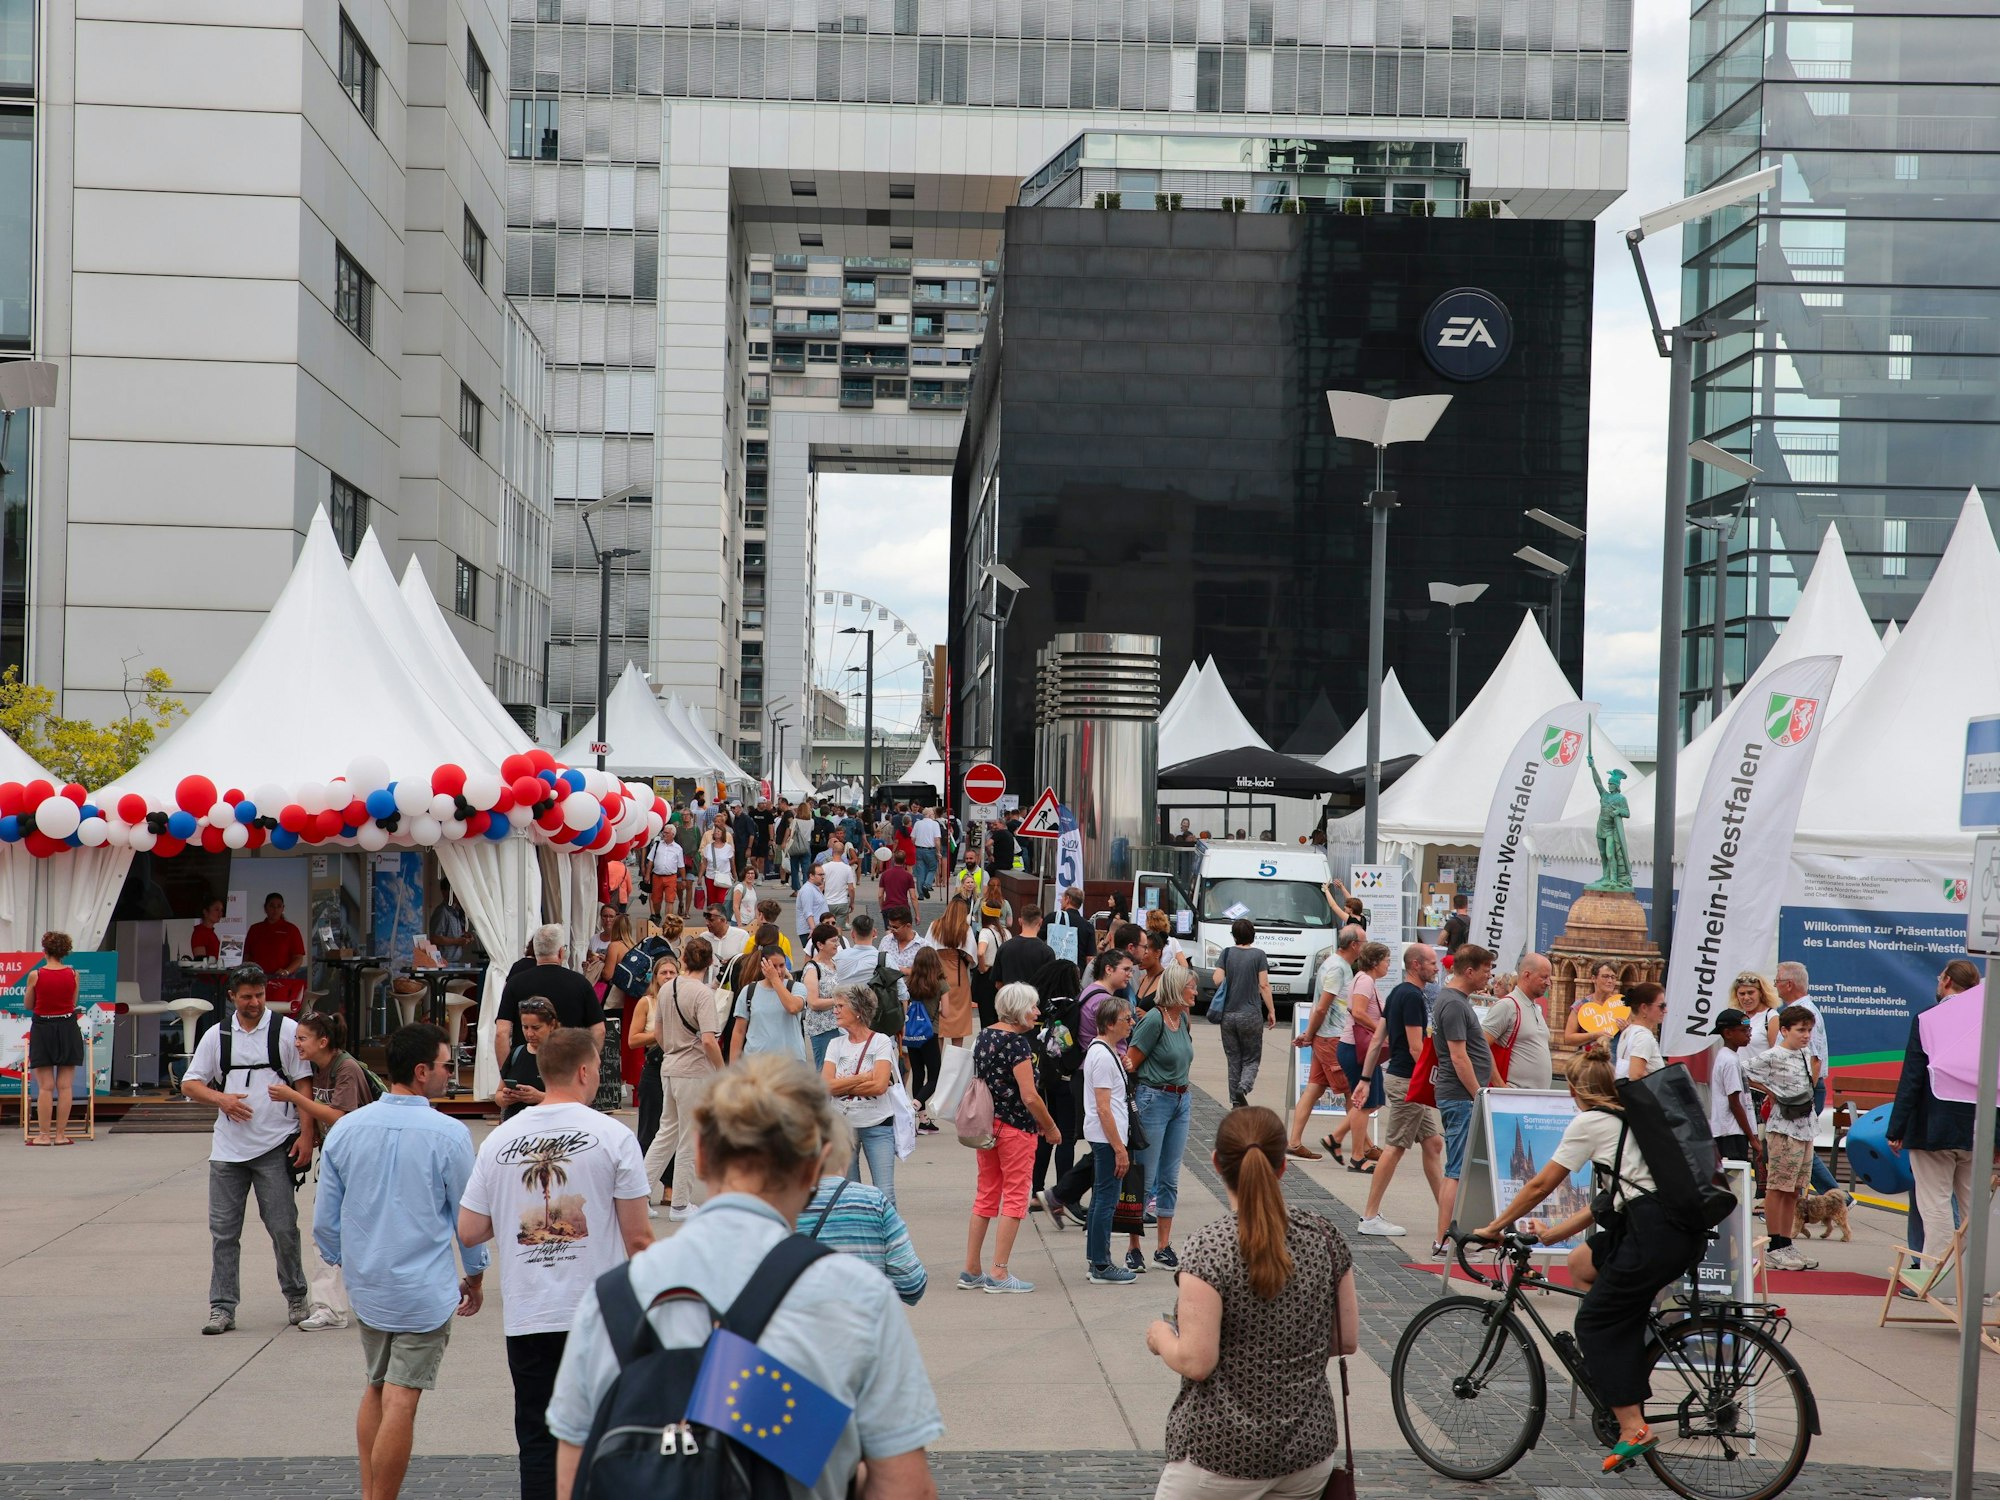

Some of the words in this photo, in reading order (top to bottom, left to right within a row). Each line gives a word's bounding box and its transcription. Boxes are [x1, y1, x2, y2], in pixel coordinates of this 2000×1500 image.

[1437, 316, 1497, 348] EA
[591, 743, 608, 754] WC
[1236, 776, 1275, 787] fritz-kola
[1058, 848, 1076, 888] 5
[1258, 863, 1277, 877] 5
[1486, 761, 1540, 972] ordrhein-Westfalen
[1804, 879, 1845, 887] Internationales
[1685, 743, 1763, 1037] Nordrhein-Westfalen
[1804, 921, 1872, 934] Willkommen
[1874, 926, 1893, 935] zur
[1895, 925, 1967, 938] Präsentation
[1803, 937, 1823, 948] des
[1826, 938, 1866, 949] Landes
[6, 961, 22, 972] ALS
[1805, 983, 1834, 992] nsere
[1835, 984, 1871, 994] Themen
[1873, 984, 1887, 994] als
[1808, 994, 1836, 1004] berste
[1838, 995, 1907, 1006] Landesbehörde
[1819, 1005, 1910, 1018] Ministerpräsidenten
